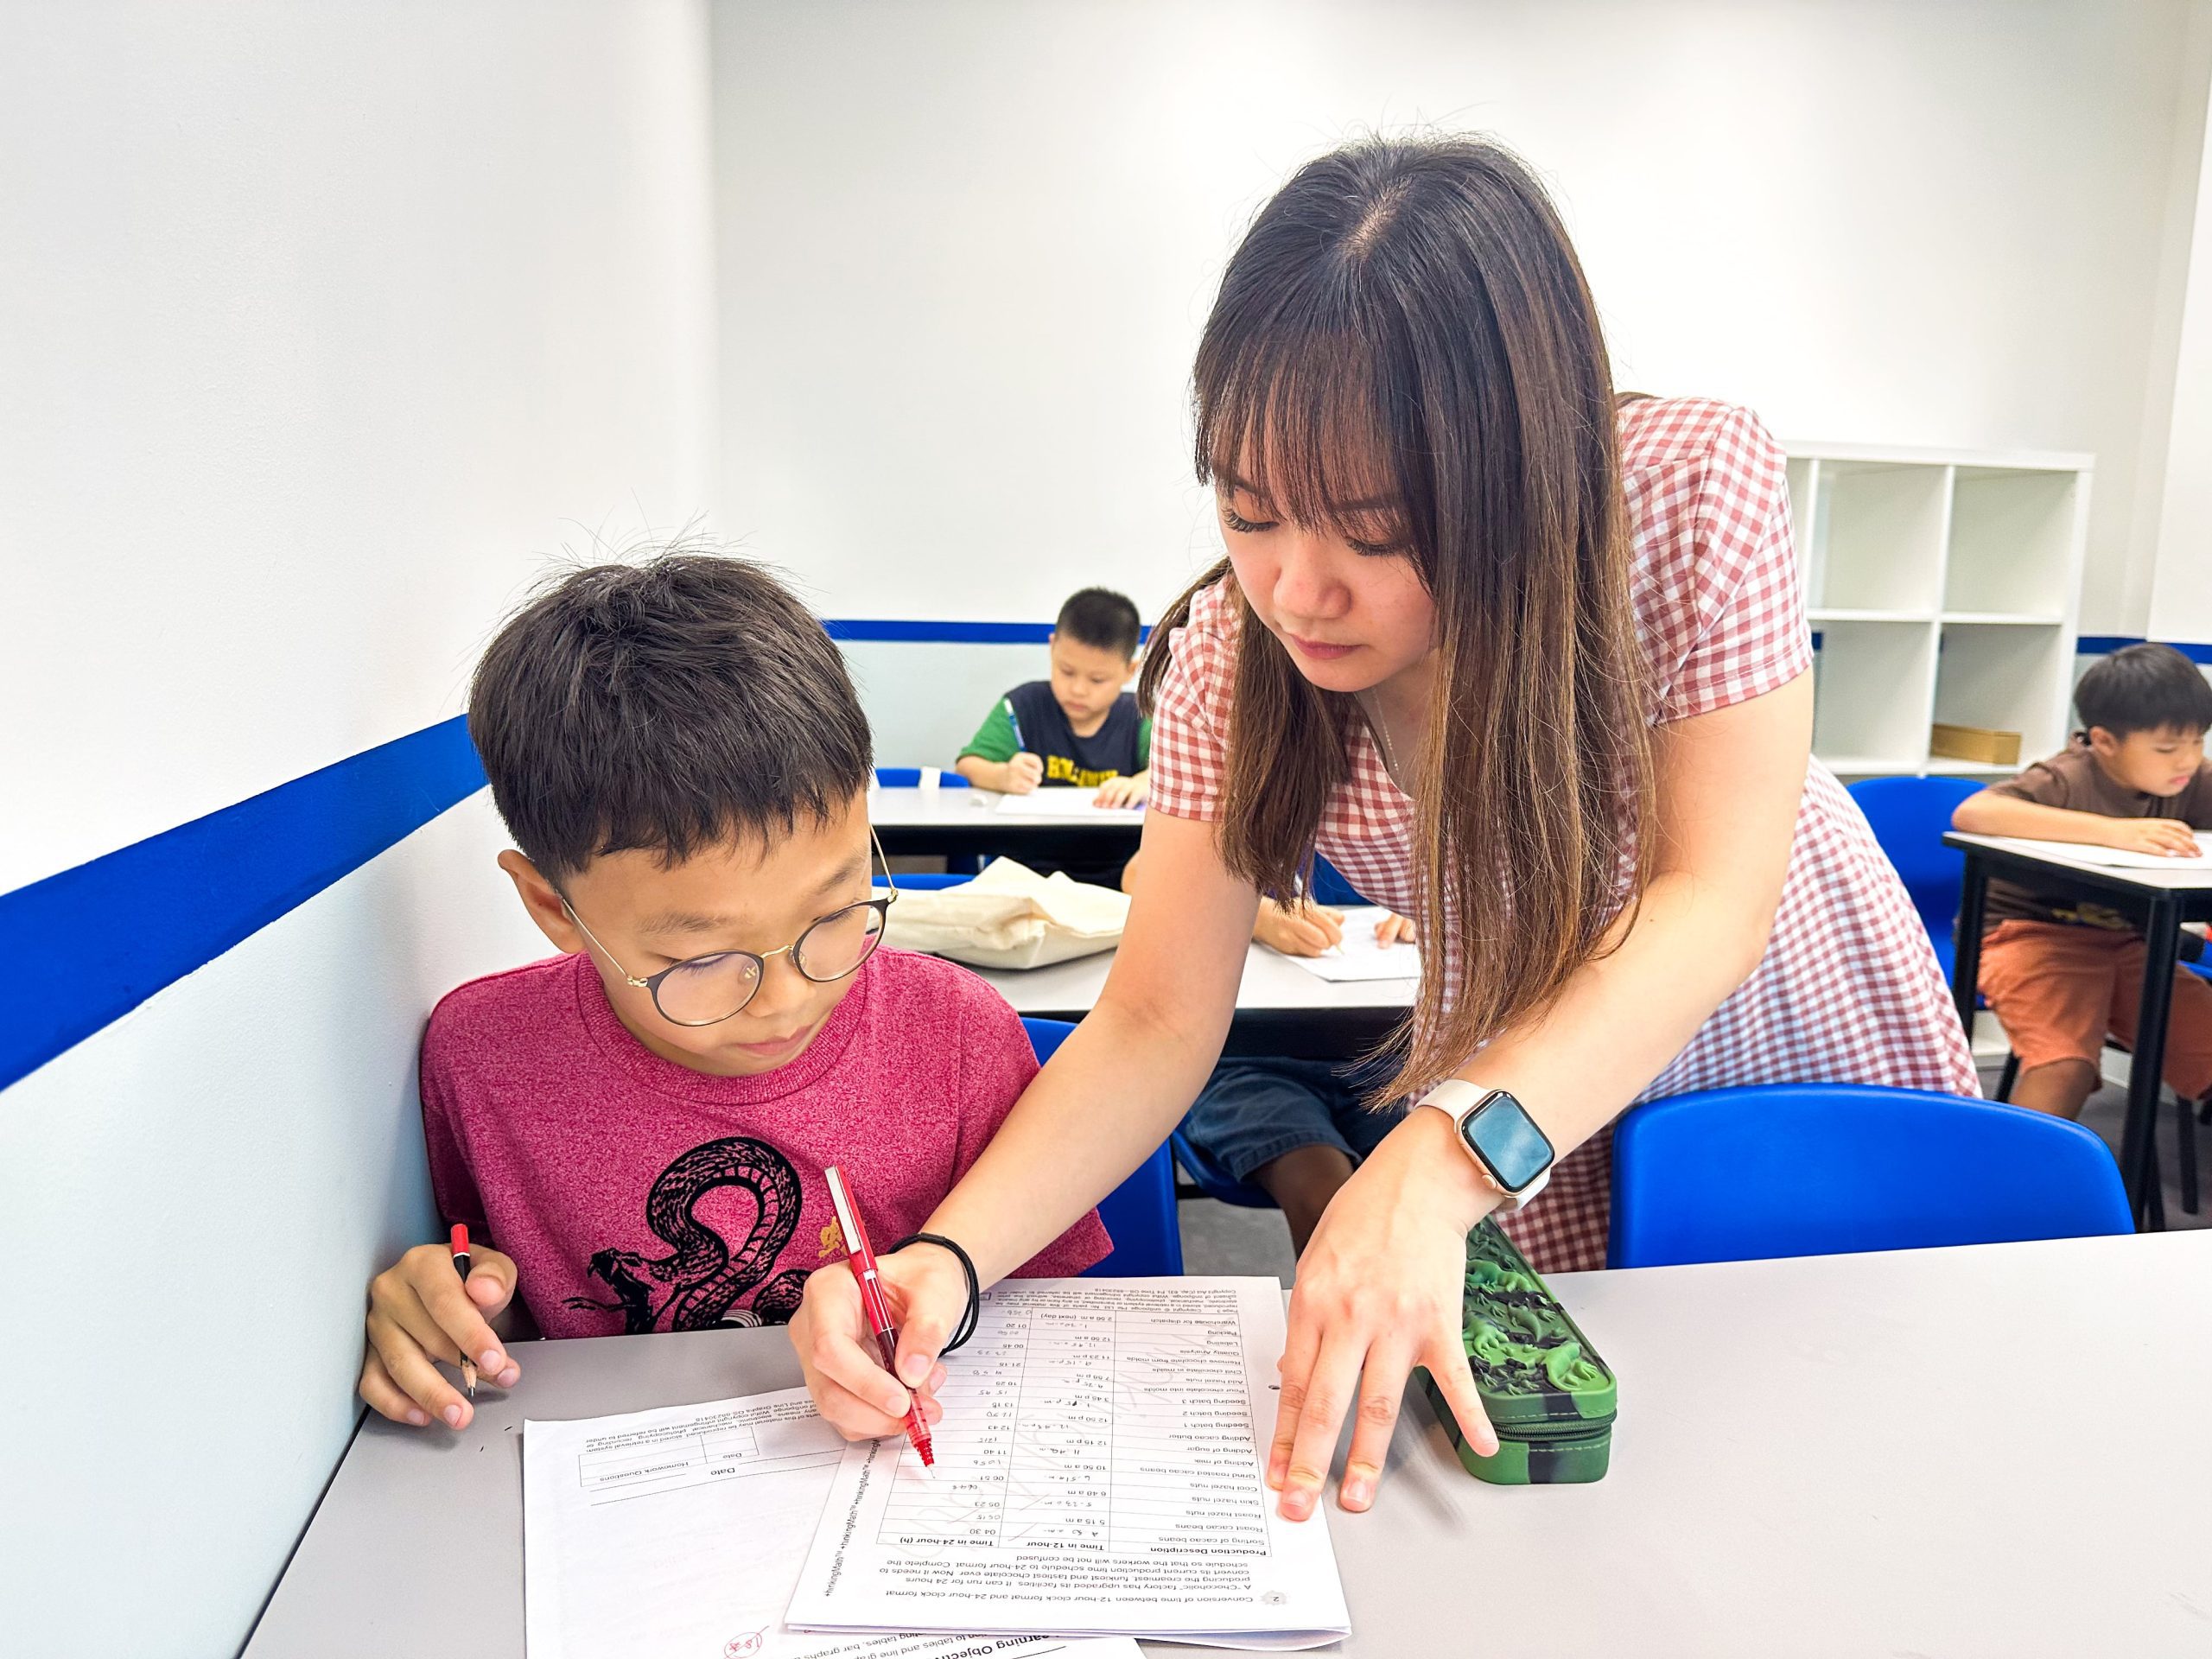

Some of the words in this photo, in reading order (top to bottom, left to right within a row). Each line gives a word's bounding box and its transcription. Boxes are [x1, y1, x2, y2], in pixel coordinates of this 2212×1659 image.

[644, 1461, 689, 1474] Homework
[710, 1467, 735, 1477] Date
[843, 1643, 861, 1652] bar
[900, 1644, 920, 1655] and
[880, 1649, 899, 1658] line
